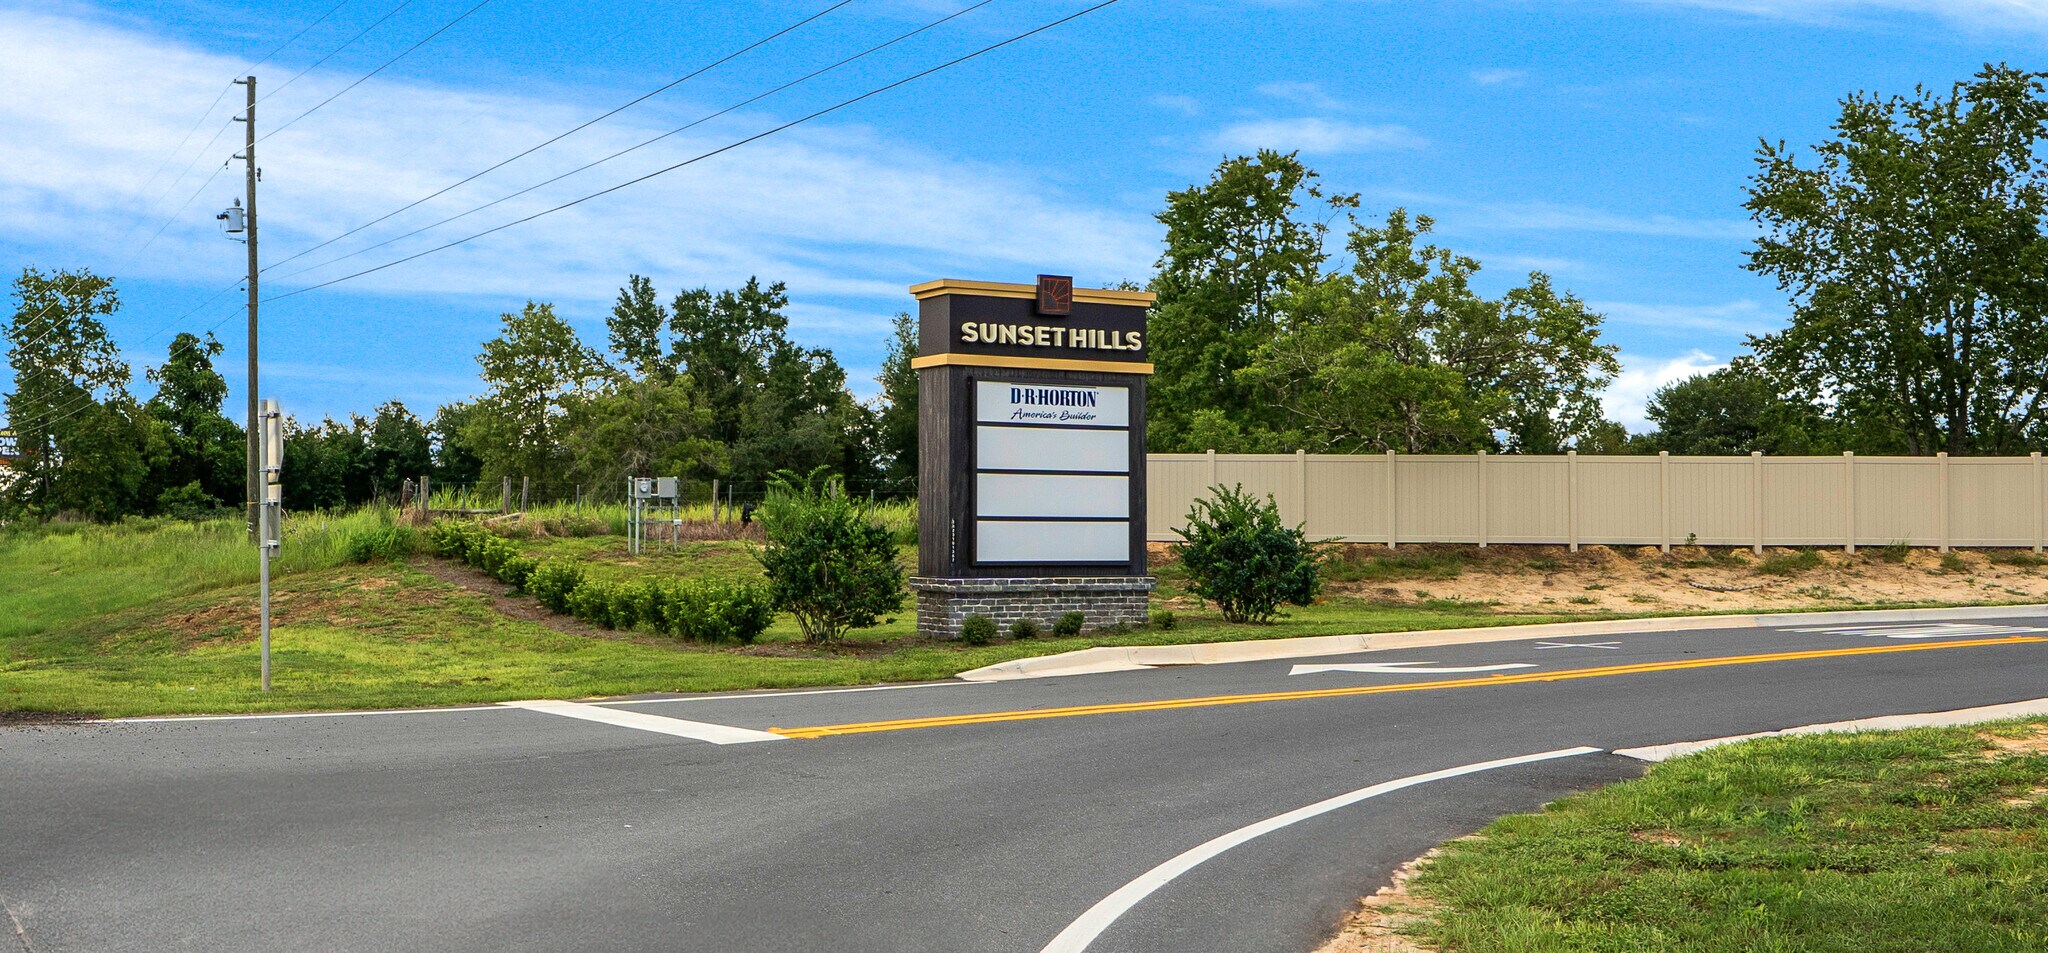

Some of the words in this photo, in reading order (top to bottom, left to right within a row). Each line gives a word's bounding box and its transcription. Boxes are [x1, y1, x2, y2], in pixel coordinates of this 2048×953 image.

[961, 321, 1065, 347] SUNSET
[1069, 328, 1142, 351] HILLS
[1010, 407, 1057, 420] America's
[1059, 410, 1097, 421] Builder
[0, 437, 18, 447] OW
